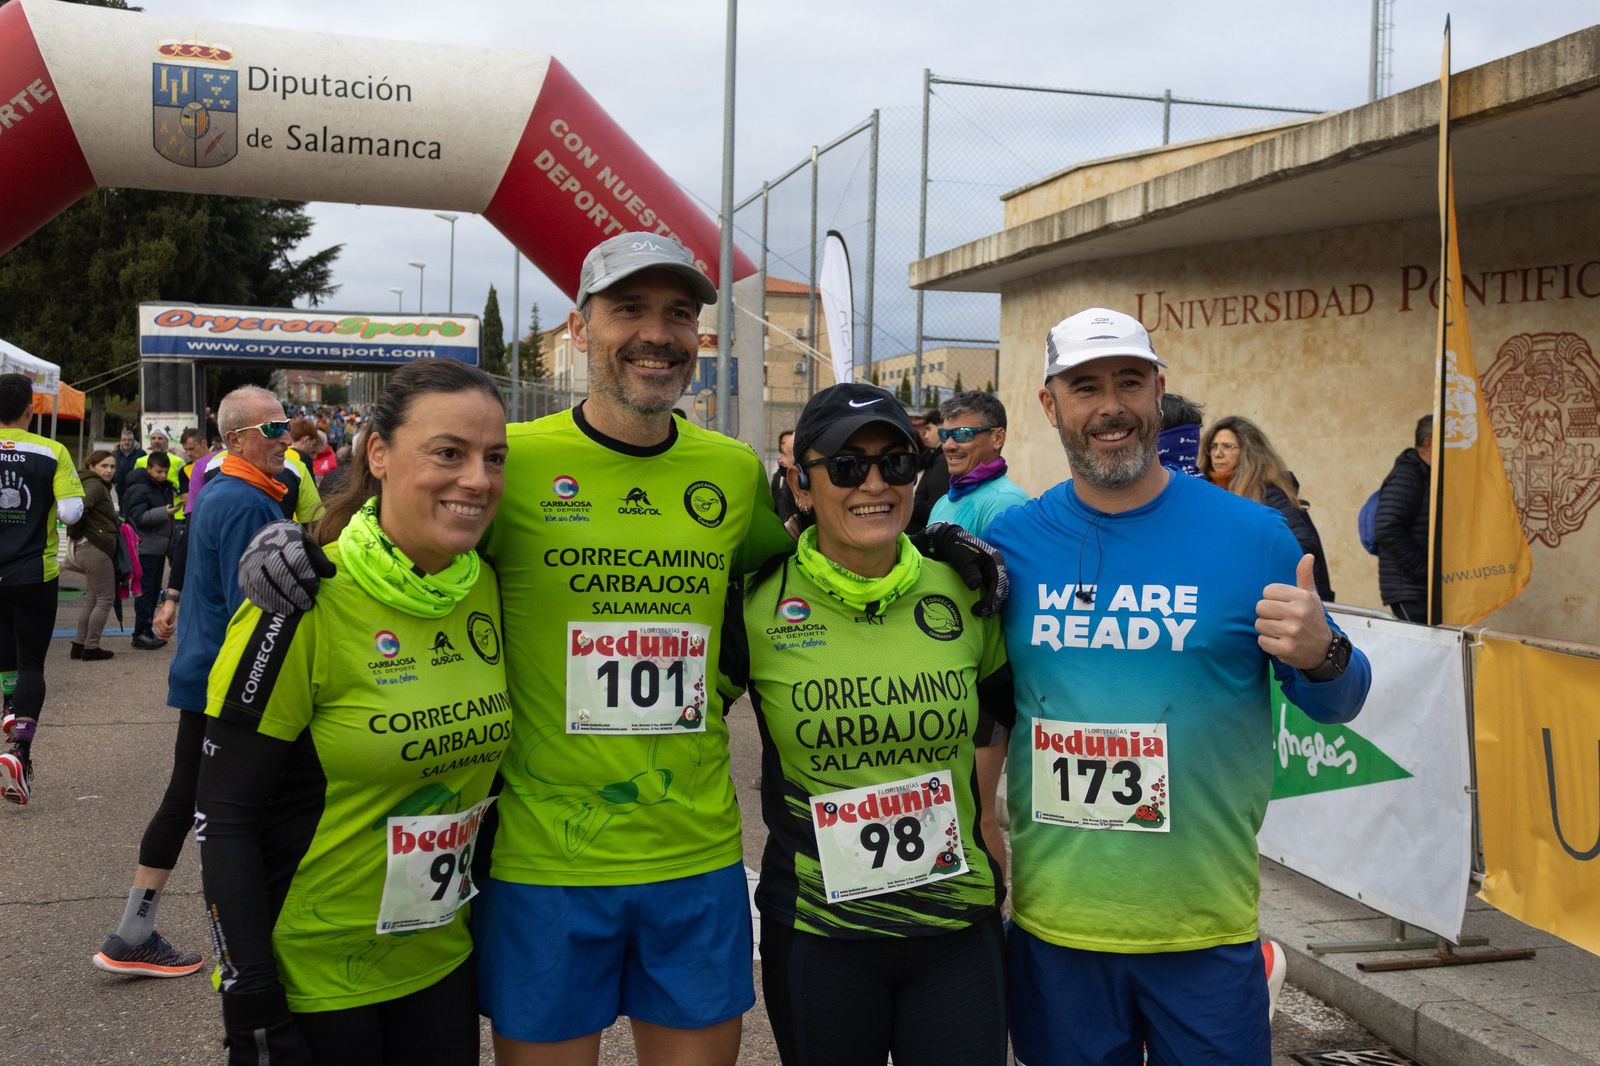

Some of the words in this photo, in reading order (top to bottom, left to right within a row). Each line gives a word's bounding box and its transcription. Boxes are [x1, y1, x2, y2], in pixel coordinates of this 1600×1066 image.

[247, 66, 412, 102] Diputación
[0, 78, 54, 135] RTE
[246, 127, 273, 149] de
[286, 124, 442, 160] Salamanca
[550, 118, 599, 169] CON
[533, 149, 629, 237] DEPORT
[187, 341, 436, 359] www.orycronsport.com
[540, 500, 592, 509] CARBAJOSA
[543, 548, 725, 571] CORRECAMINOS
[569, 574, 710, 594] CARBAJOSA
[1038, 583, 1098, 611] WE
[1107, 584, 1199, 617] ARE
[592, 601, 692, 615] SALAMANCA
[571, 629, 705, 657] bedunia
[766, 624, 827, 635] CARBAJOSA
[786, 630, 826, 641] DEPORTE
[1031, 614, 1197, 652] READY
[368, 657, 416, 669] CARBAJOSA
[597, 660, 684, 708] 101
[792, 670, 968, 712] CORRECAMINOS
[796, 707, 968, 750] CARBAJOSA
[1034, 725, 1164, 757] bedunia
[810, 744, 959, 772] SALAMANCA
[877, 781, 919, 795] FLORISTERÍAS
[1053, 756, 1142, 805] 173
[815, 781, 952, 828] bedunia
[860, 816, 925, 869] 98
[136, 900, 152, 919] NIKE
